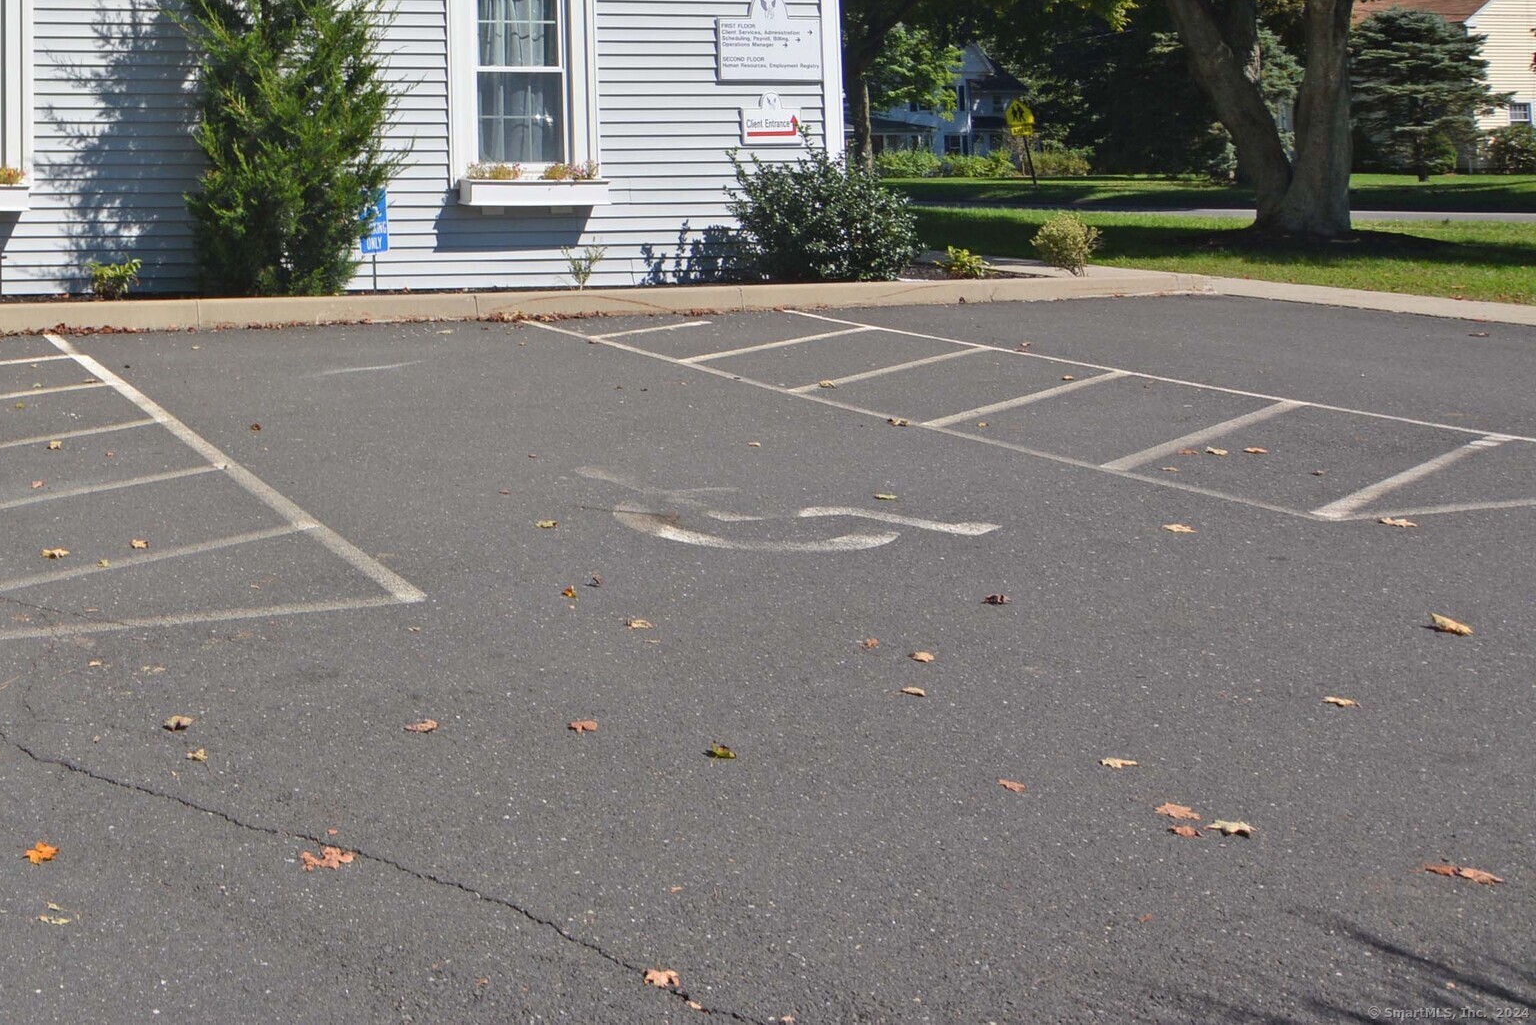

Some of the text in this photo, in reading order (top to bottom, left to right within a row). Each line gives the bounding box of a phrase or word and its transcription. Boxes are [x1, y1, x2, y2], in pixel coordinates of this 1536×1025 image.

[746, 119, 790, 128] Client Entrance
[367, 236, 383, 250] ONLY
